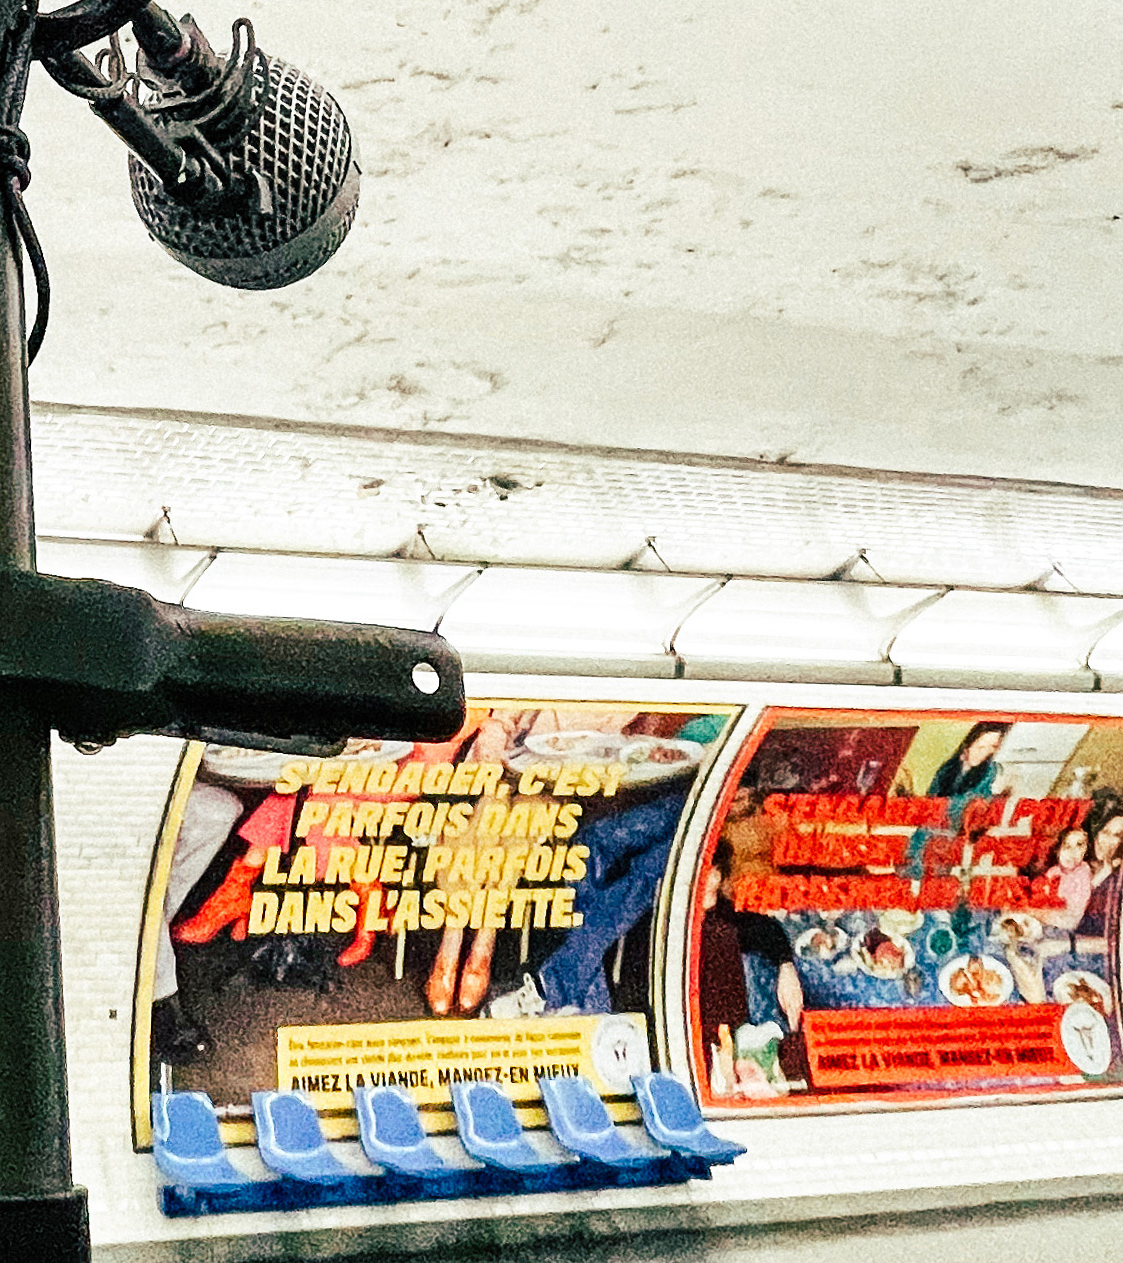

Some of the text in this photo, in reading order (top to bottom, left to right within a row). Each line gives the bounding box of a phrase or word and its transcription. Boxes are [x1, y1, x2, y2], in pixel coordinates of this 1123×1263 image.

[275, 761, 628, 798] S'ENGAGER, C'EST
[295, 801, 584, 839] PARFOIS DANS
[262, 845, 592, 885] LA RUE, PARFOIS
[247, 888, 585, 935] DANS L'ASSIETTE.
[291, 1073, 343, 1092] AIMEZ
[345, 1071, 366, 1092] LA
